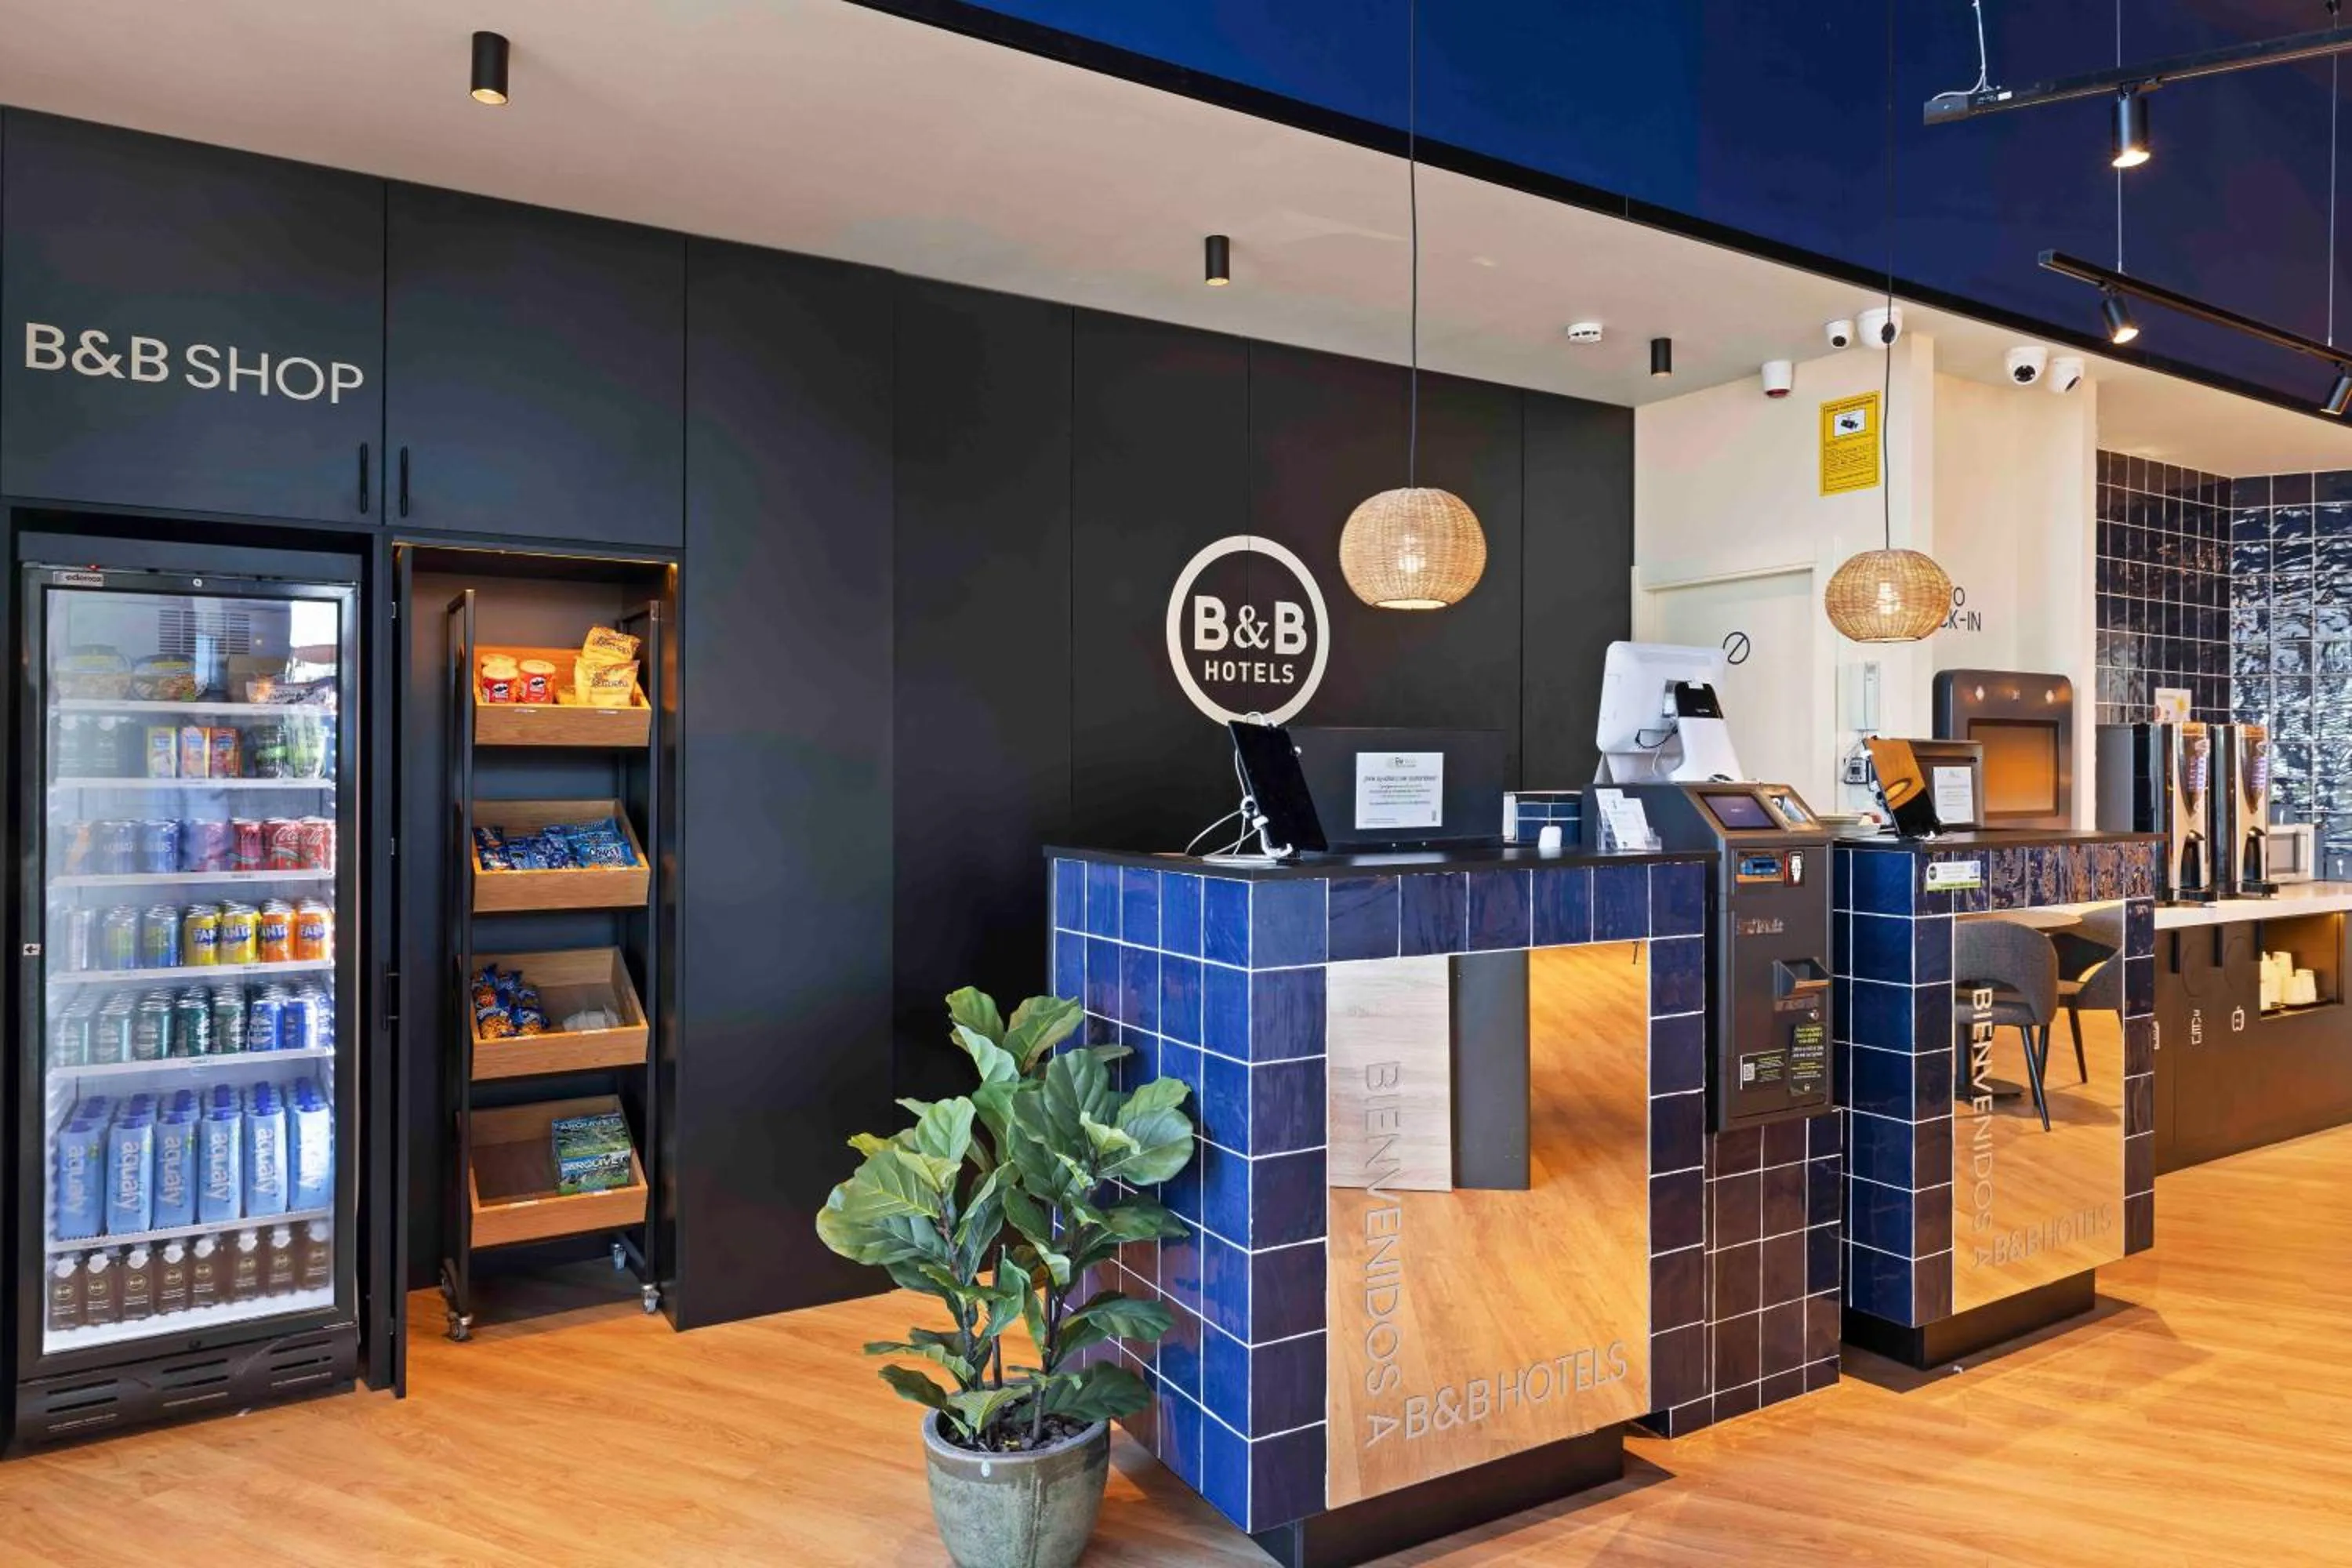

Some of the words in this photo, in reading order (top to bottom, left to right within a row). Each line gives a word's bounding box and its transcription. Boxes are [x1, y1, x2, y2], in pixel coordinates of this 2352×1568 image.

[25, 321, 169, 383] B&B
[185, 344, 364, 404] SHOP
[1194, 594, 1308, 655] B&B
[1204, 659, 1295, 684] HOTELS
[1972, 986, 1994, 1232] BIENVENIDOS
[1364, 1060, 1403, 1396] BIENVENIDOS
[1403, 1377, 1491, 1440] B&B
[1498, 1340, 1628, 1414] HOTELS
[1364, 1414, 1403, 1450] A
